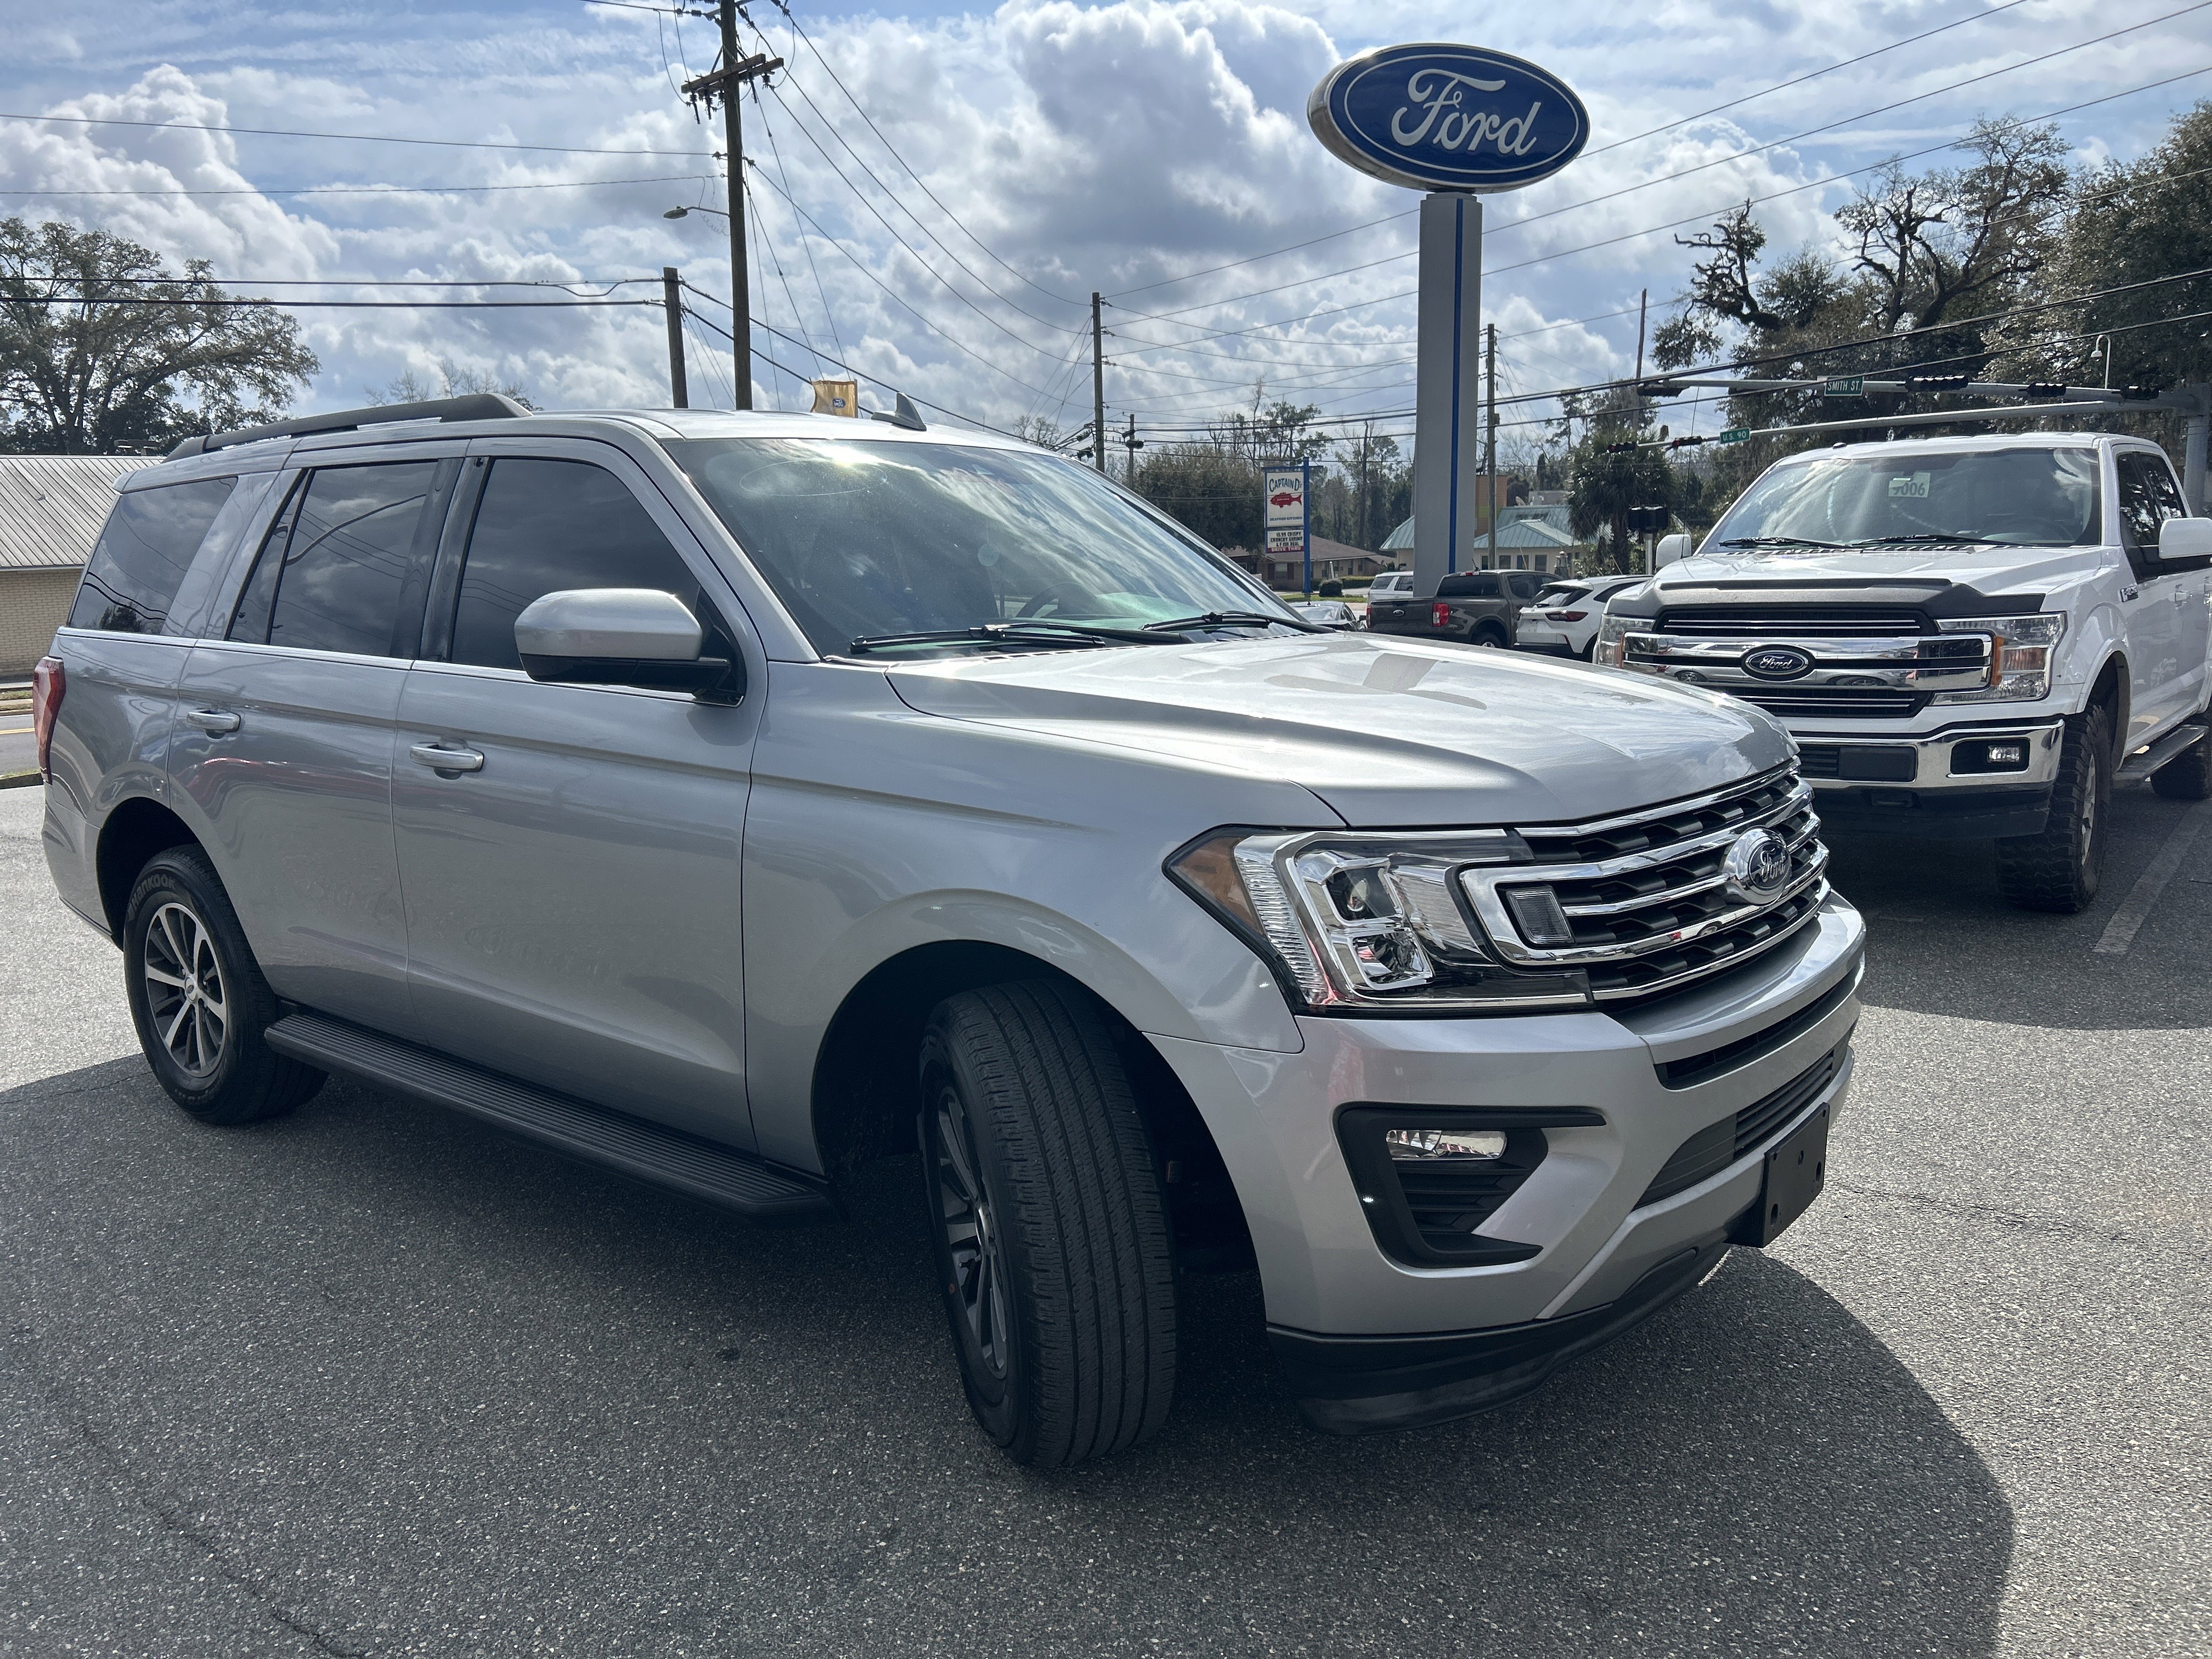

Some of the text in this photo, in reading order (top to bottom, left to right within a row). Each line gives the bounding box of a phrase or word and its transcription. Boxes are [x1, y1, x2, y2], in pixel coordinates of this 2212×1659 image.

[1391, 69, 1541, 156] Ford
[1827, 380, 1860, 391] SMITH ST.
[1737, 430, 1747, 438] 90
[1269, 478, 1294, 492] CAPTAIN
[1759, 655, 1793, 669] Ford
[1761, 848, 1786, 882] Ford
